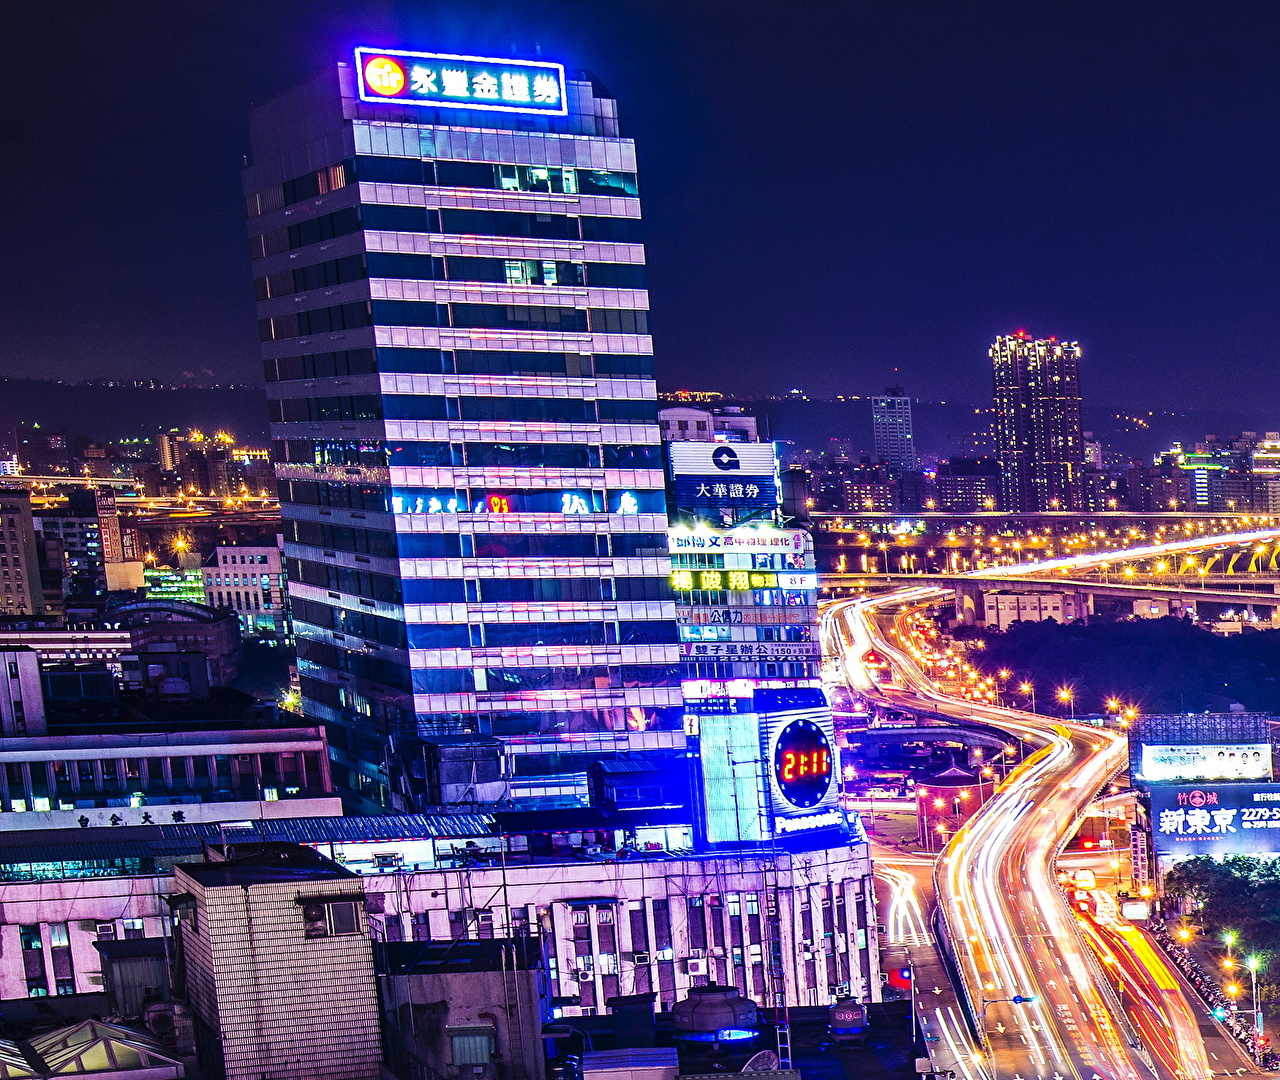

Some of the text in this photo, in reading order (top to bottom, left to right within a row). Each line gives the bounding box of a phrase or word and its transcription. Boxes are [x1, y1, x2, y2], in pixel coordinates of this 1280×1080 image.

[410, 66, 560, 104] 永豐金證券
[696, 483, 760, 498] 大華證券
[695, 645, 768, 655] 雙子星辦公
[783, 751, 828, 781] 21:11
[775, 809, 843, 833] Panasonic
[1159, 808, 1237, 835] 新東京
